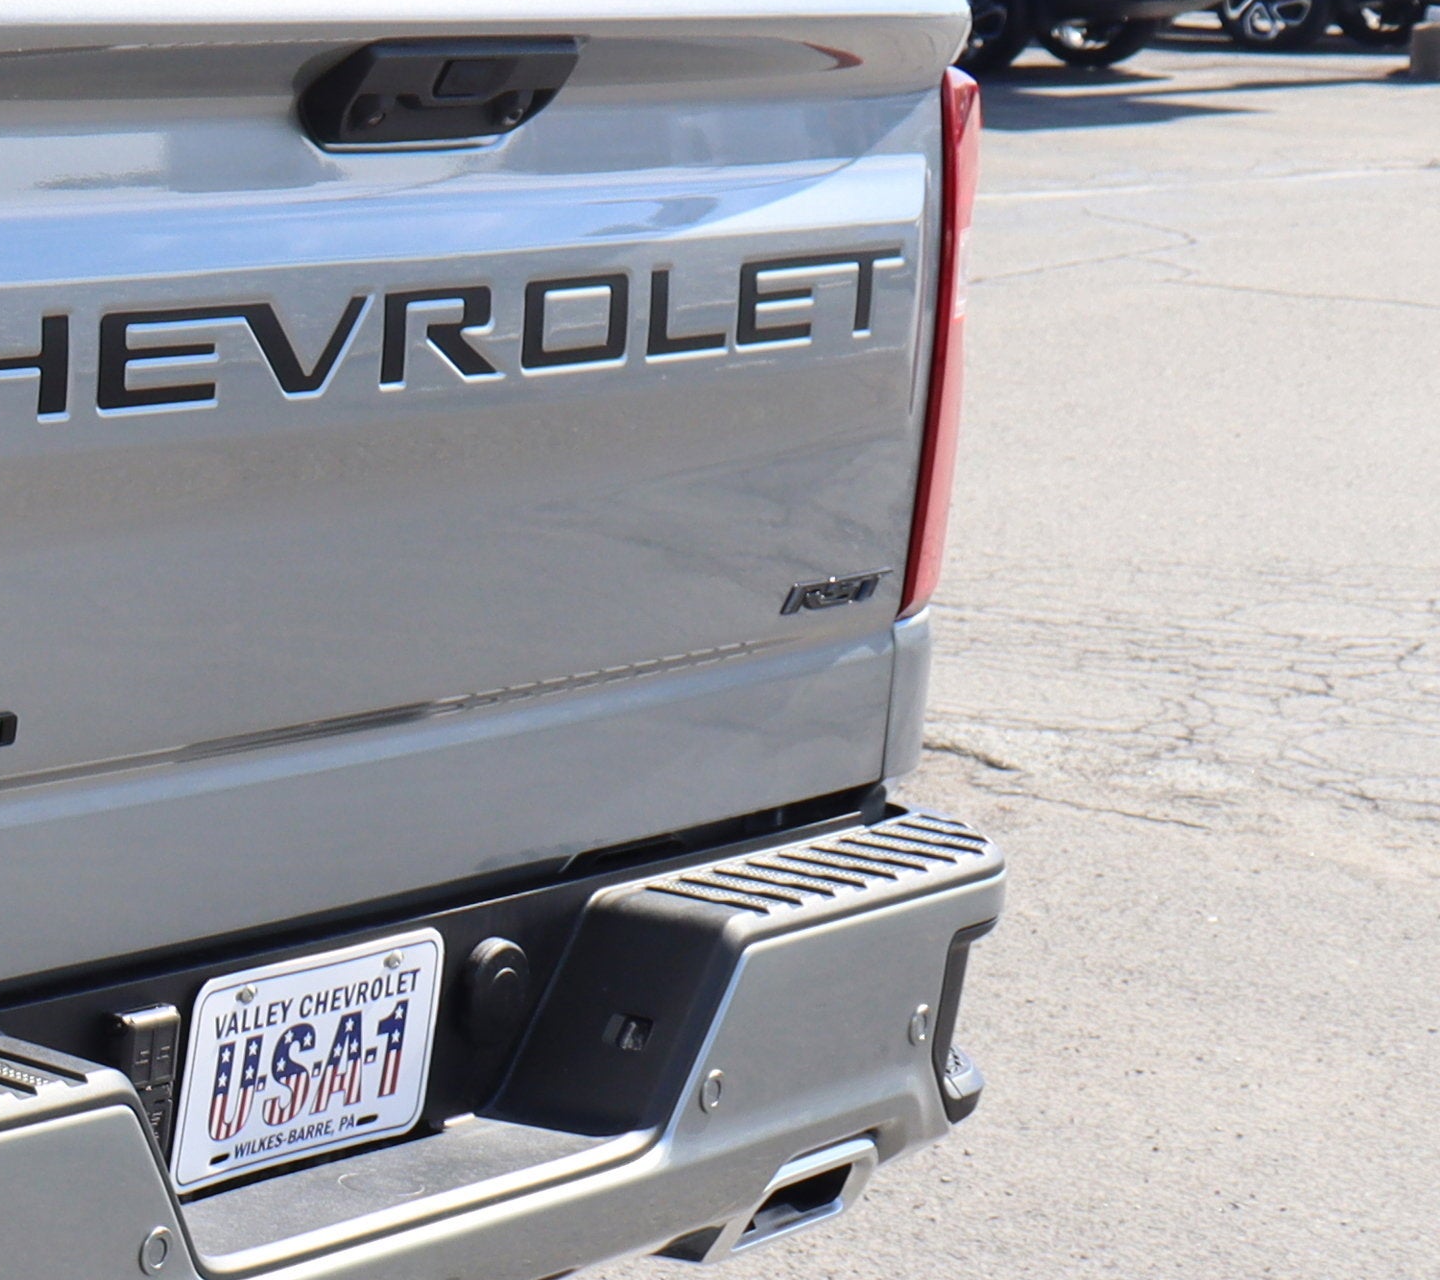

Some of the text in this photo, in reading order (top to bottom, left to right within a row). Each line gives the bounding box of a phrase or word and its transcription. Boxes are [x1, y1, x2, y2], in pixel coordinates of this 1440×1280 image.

[780, 568, 893, 615] RST
[214, 967, 422, 1040] VALLEY CHEVROLET
[234, 1113, 356, 1159] WILKES-BARRE, PA
